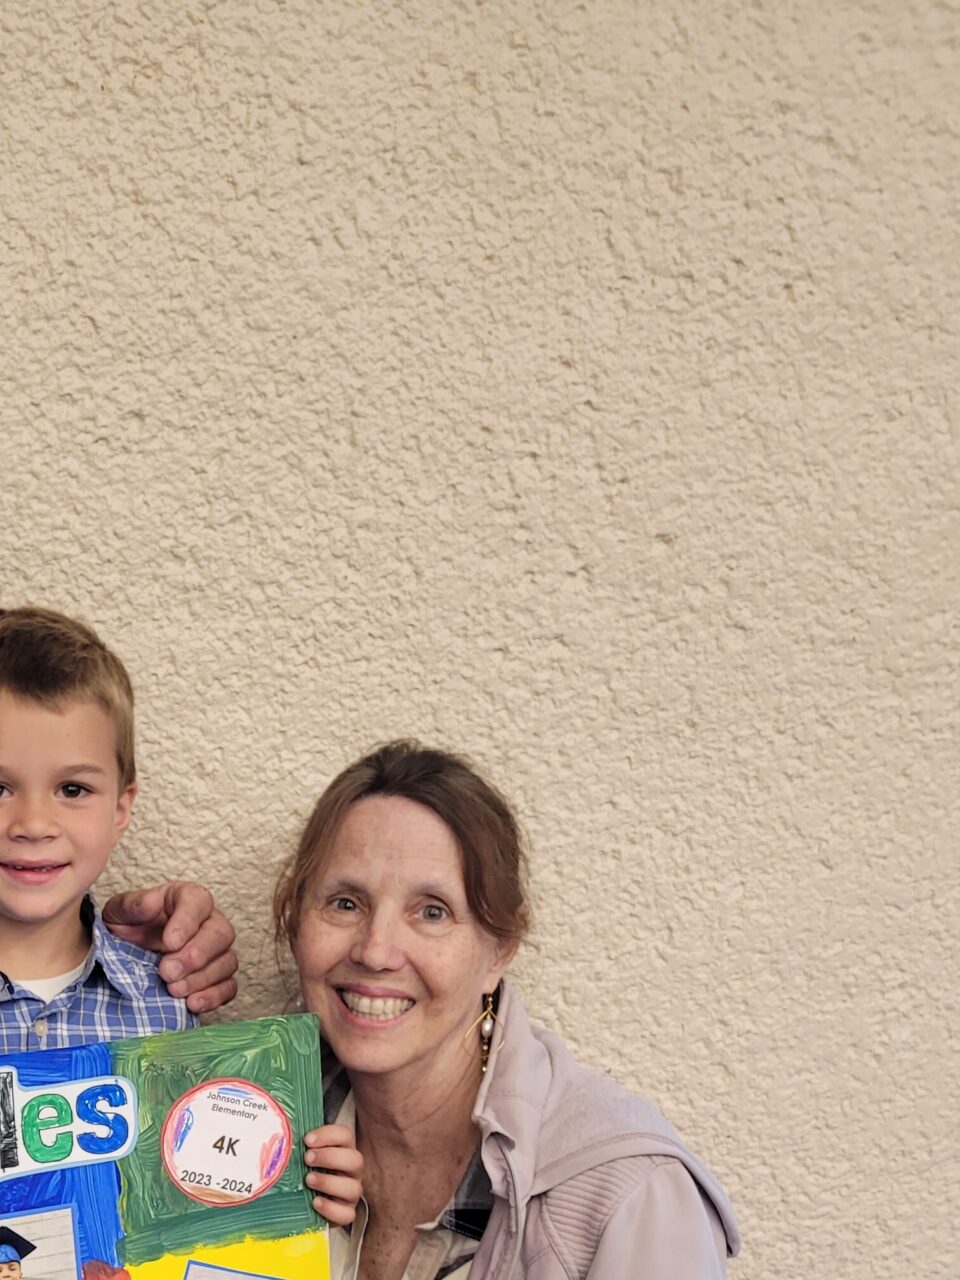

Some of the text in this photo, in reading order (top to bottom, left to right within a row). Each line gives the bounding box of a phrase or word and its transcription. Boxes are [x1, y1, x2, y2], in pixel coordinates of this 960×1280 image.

[207, 1092, 268, 1112] Johnson Creek
[211, 1103, 258, 1122] Elementary
[212, 1135, 240, 1157] 4K
[180, 1169, 212, 1187] 2023
